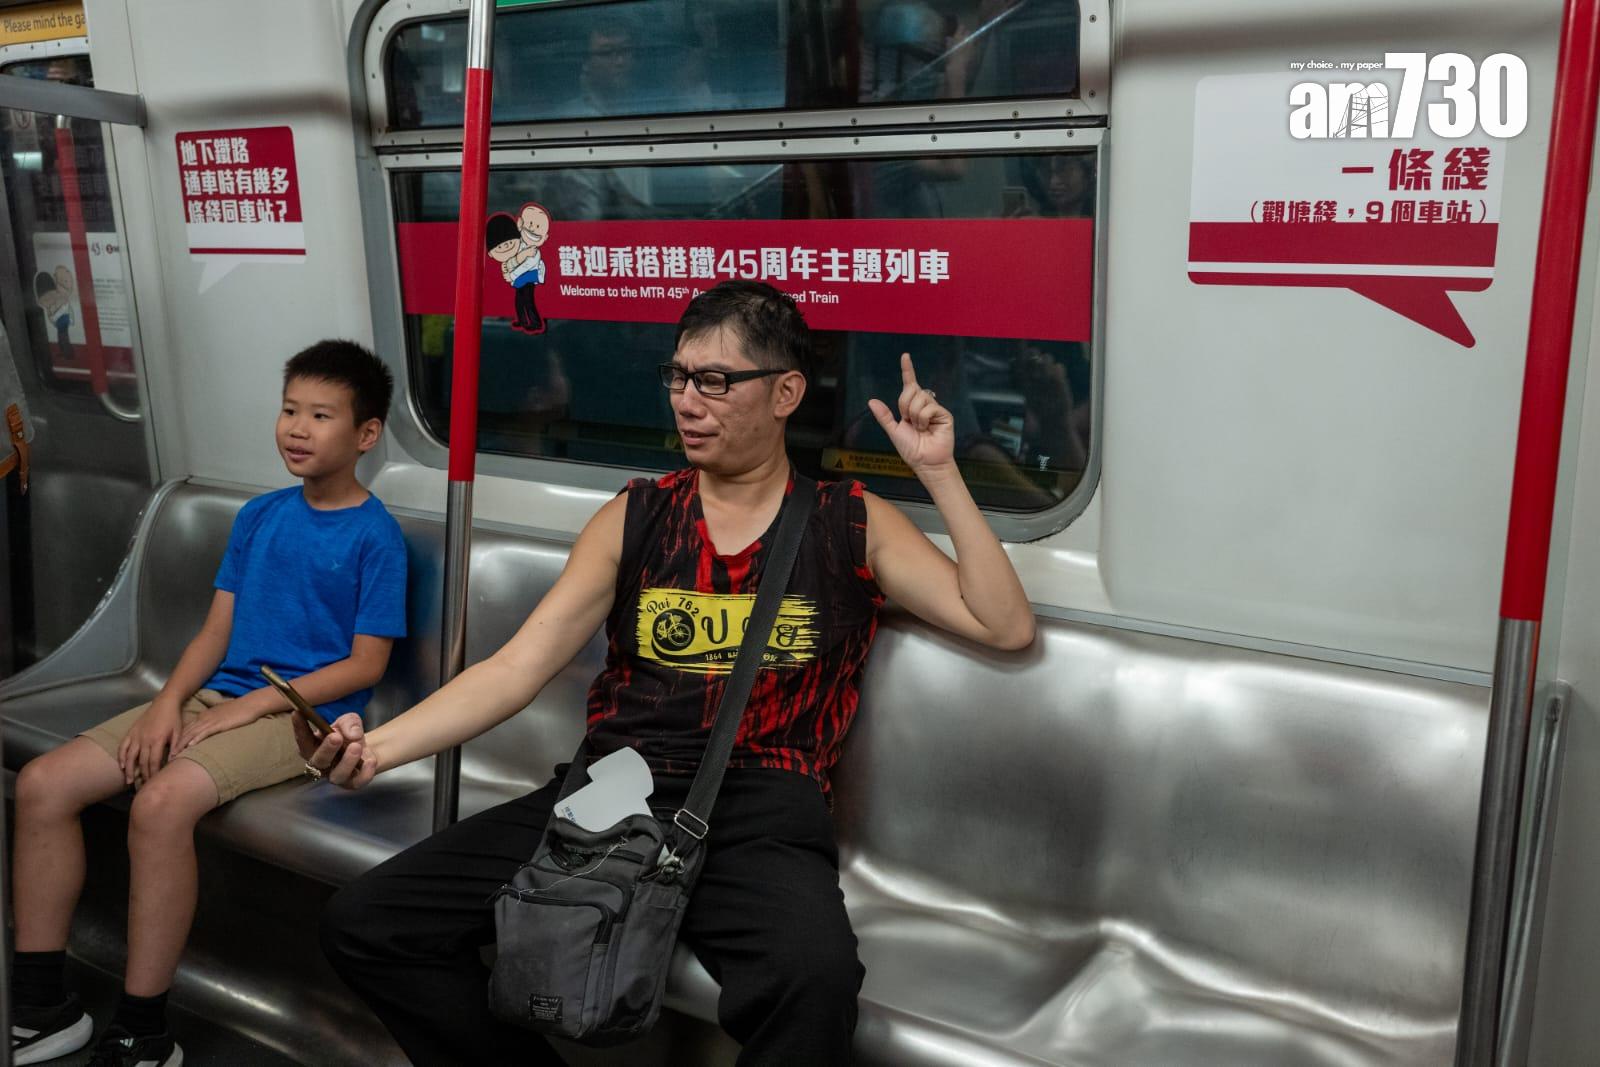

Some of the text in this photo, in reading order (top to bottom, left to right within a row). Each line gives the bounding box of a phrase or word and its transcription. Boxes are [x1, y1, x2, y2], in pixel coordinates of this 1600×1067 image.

[4, 19, 32, 33] Please
[33, 13, 57, 30] mind
[58, 11, 73, 27] the
[181, 137, 250, 166] 地下鐵路
[184, 167, 290, 196] 通車時有幾多
[560, 284, 605, 297] Welcome
[607, 286, 619, 297] to
[621, 286, 638, 298] the
[640, 286, 665, 298] MTR
[809, 290, 839, 304] Train
[678, 597, 700, 617] 762
